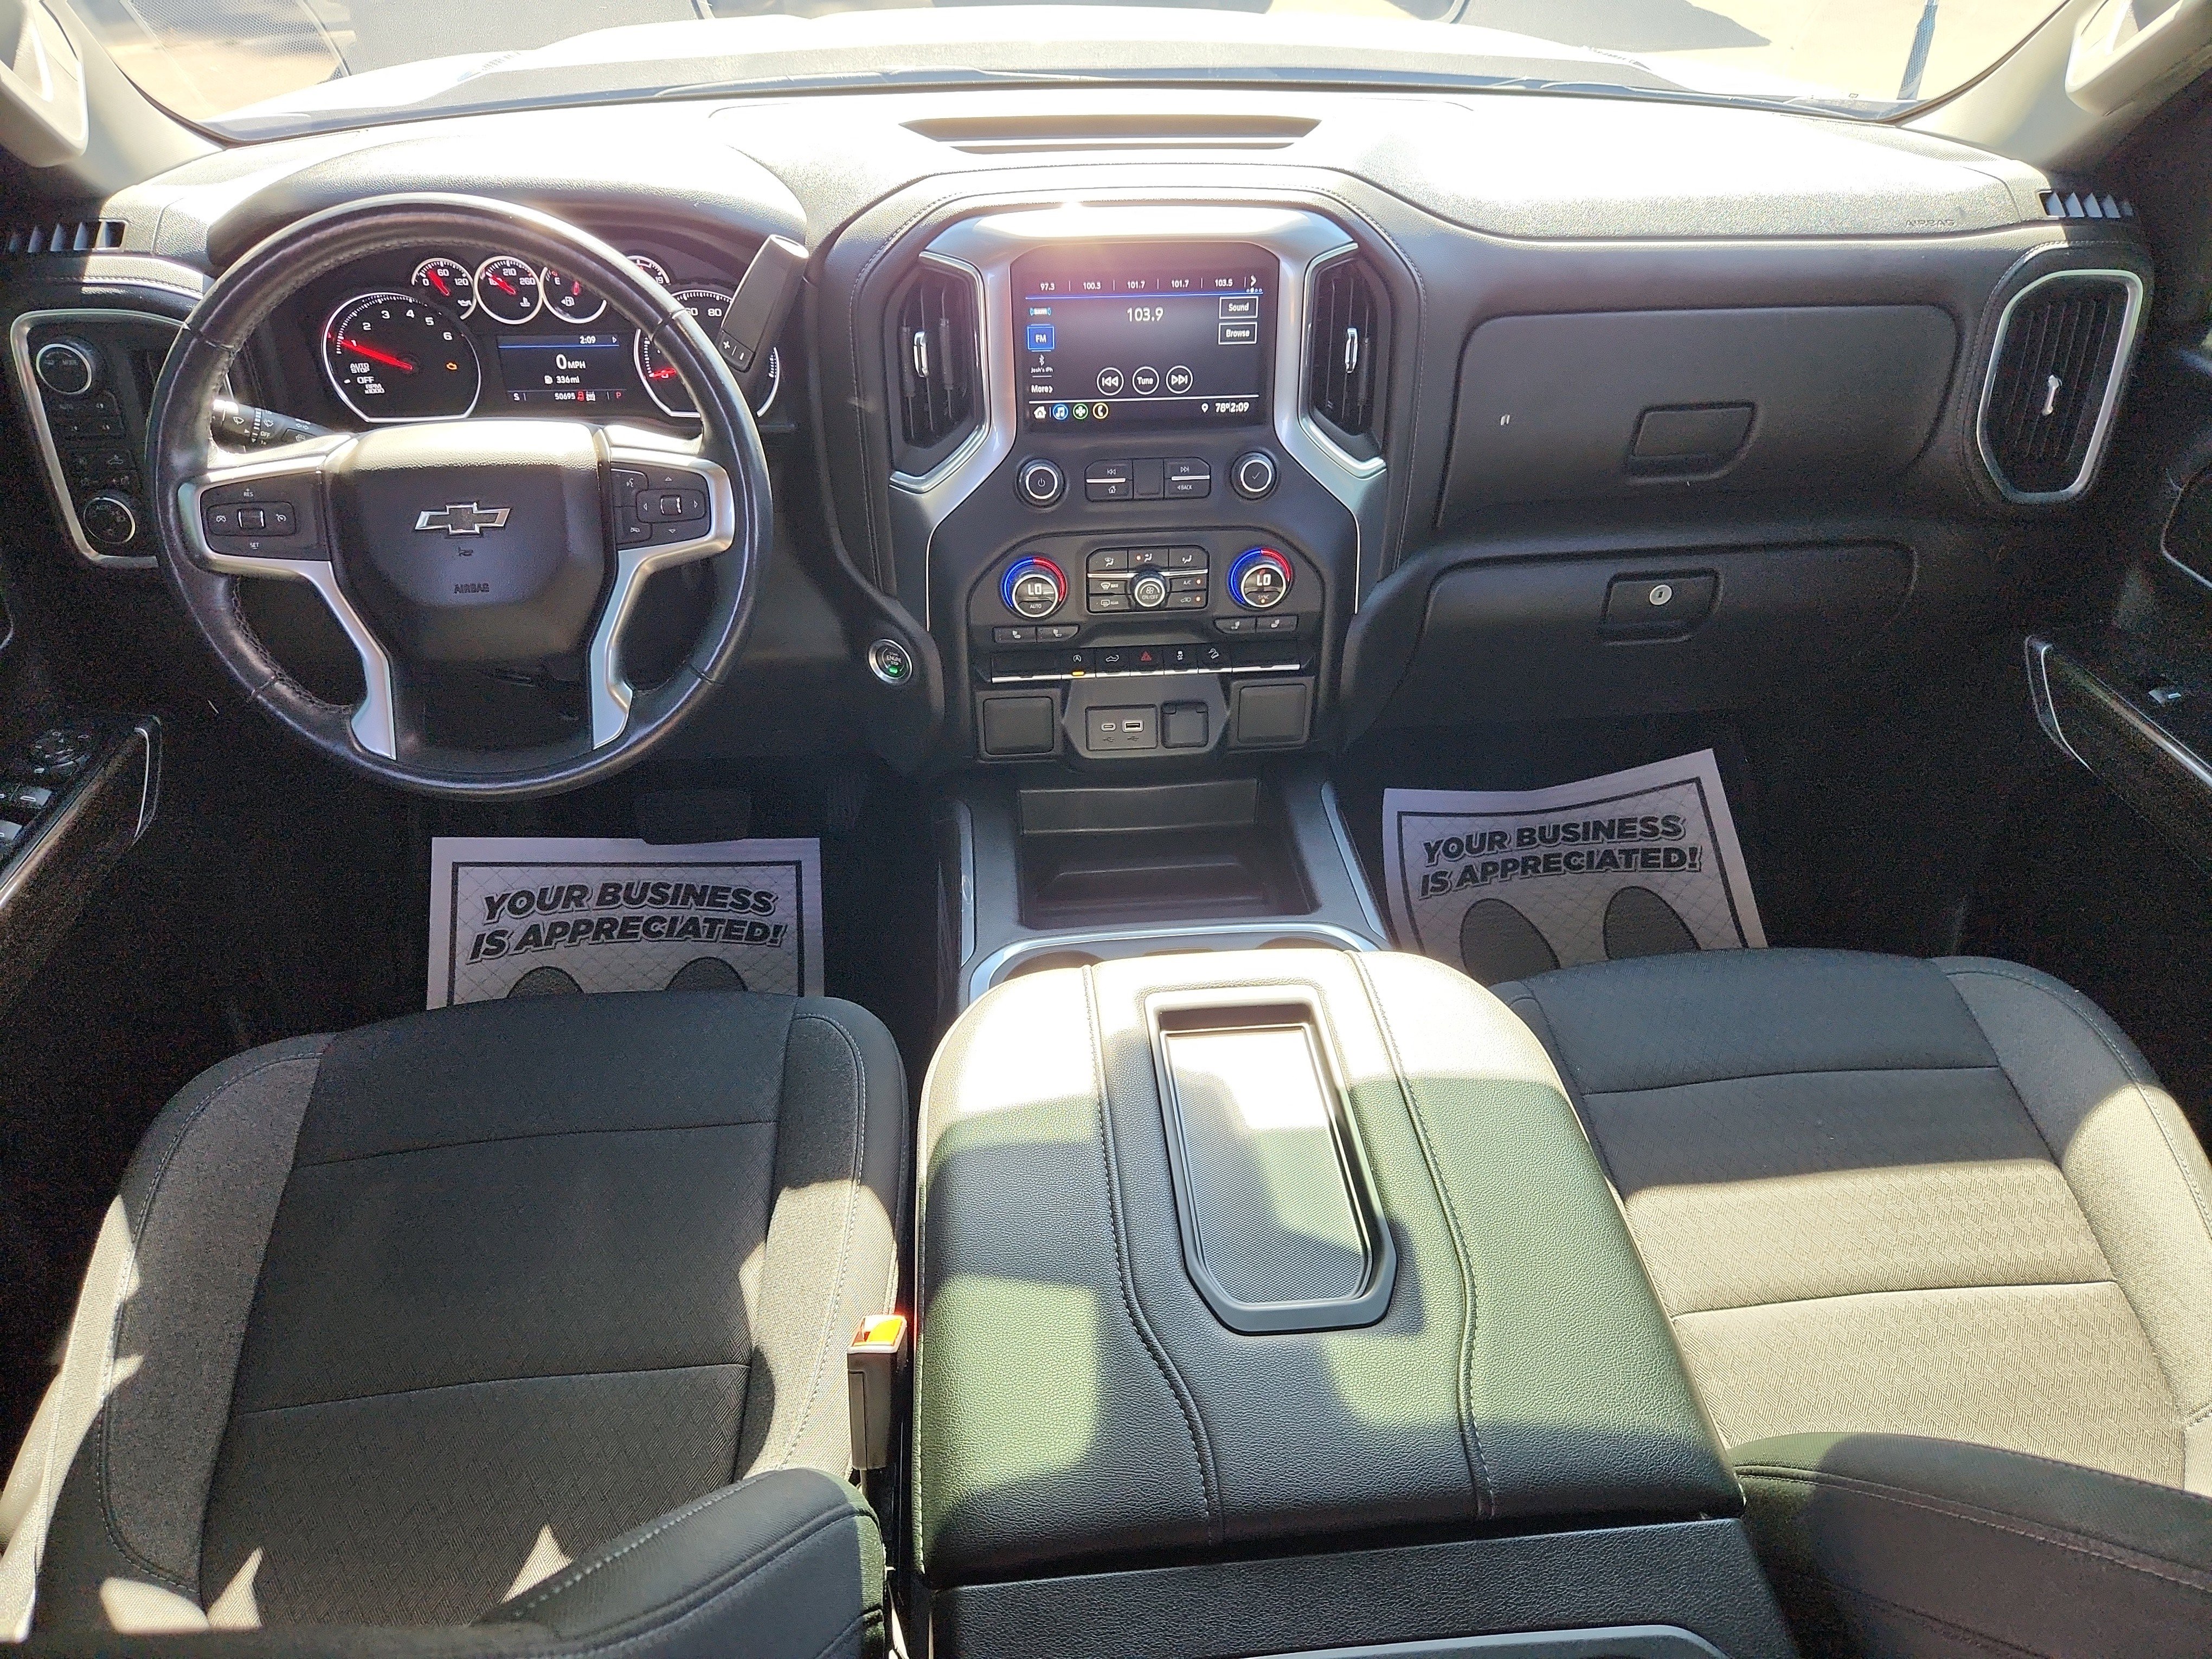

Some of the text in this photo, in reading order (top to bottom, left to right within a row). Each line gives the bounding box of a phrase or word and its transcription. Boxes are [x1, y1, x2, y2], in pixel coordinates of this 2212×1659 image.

[437, 268, 449, 276] 60
[503, 268, 517, 276] 210
[422, 277, 430, 286] 0
[454, 278, 468, 286] 120
[519, 277, 536, 285] 260
[554, 277, 561, 285] E
[655, 276, 664, 284] 19
[1127, 280, 1146, 289] 101.7
[1171, 279, 1189, 288] 101.7
[1214, 278, 1233, 287] 103.5
[1040, 282, 1055, 291] 97.3
[1083, 281, 1101, 290] 100.3
[1228, 303, 1250, 312] Sound
[381, 310, 390, 319] 3
[406, 309, 415, 318] 4
[708, 308, 722, 317] 80
[1126, 307, 1165, 322] 103.9
[425, 317, 435, 326] 5
[362, 322, 371, 331] 2
[443, 331, 453, 340] 6
[1225, 329, 1250, 338] Browse
[579, 335, 596, 344] 2:09
[1035, 334, 1047, 343] FM
[556, 353, 586, 370] 0 MPH
[356, 376, 375, 384] OFF
[1137, 377, 1154, 385] Tune
[1031, 385, 1050, 394] More
[513, 393, 520, 401] S
[260, 430, 271, 439] OFF
[1257, 574, 1271, 586] LO
[454, 582, 490, 594] AIRBAG
[1027, 583, 1042, 595] LO
[1423, 813, 1687, 867] YOUR BUSINESS
[1418, 844, 1704, 900] IS APPRECIATED!
[482, 880, 778, 924] YOUR BUSINESS
[465, 912, 789, 965] IS APPRECIATED!
